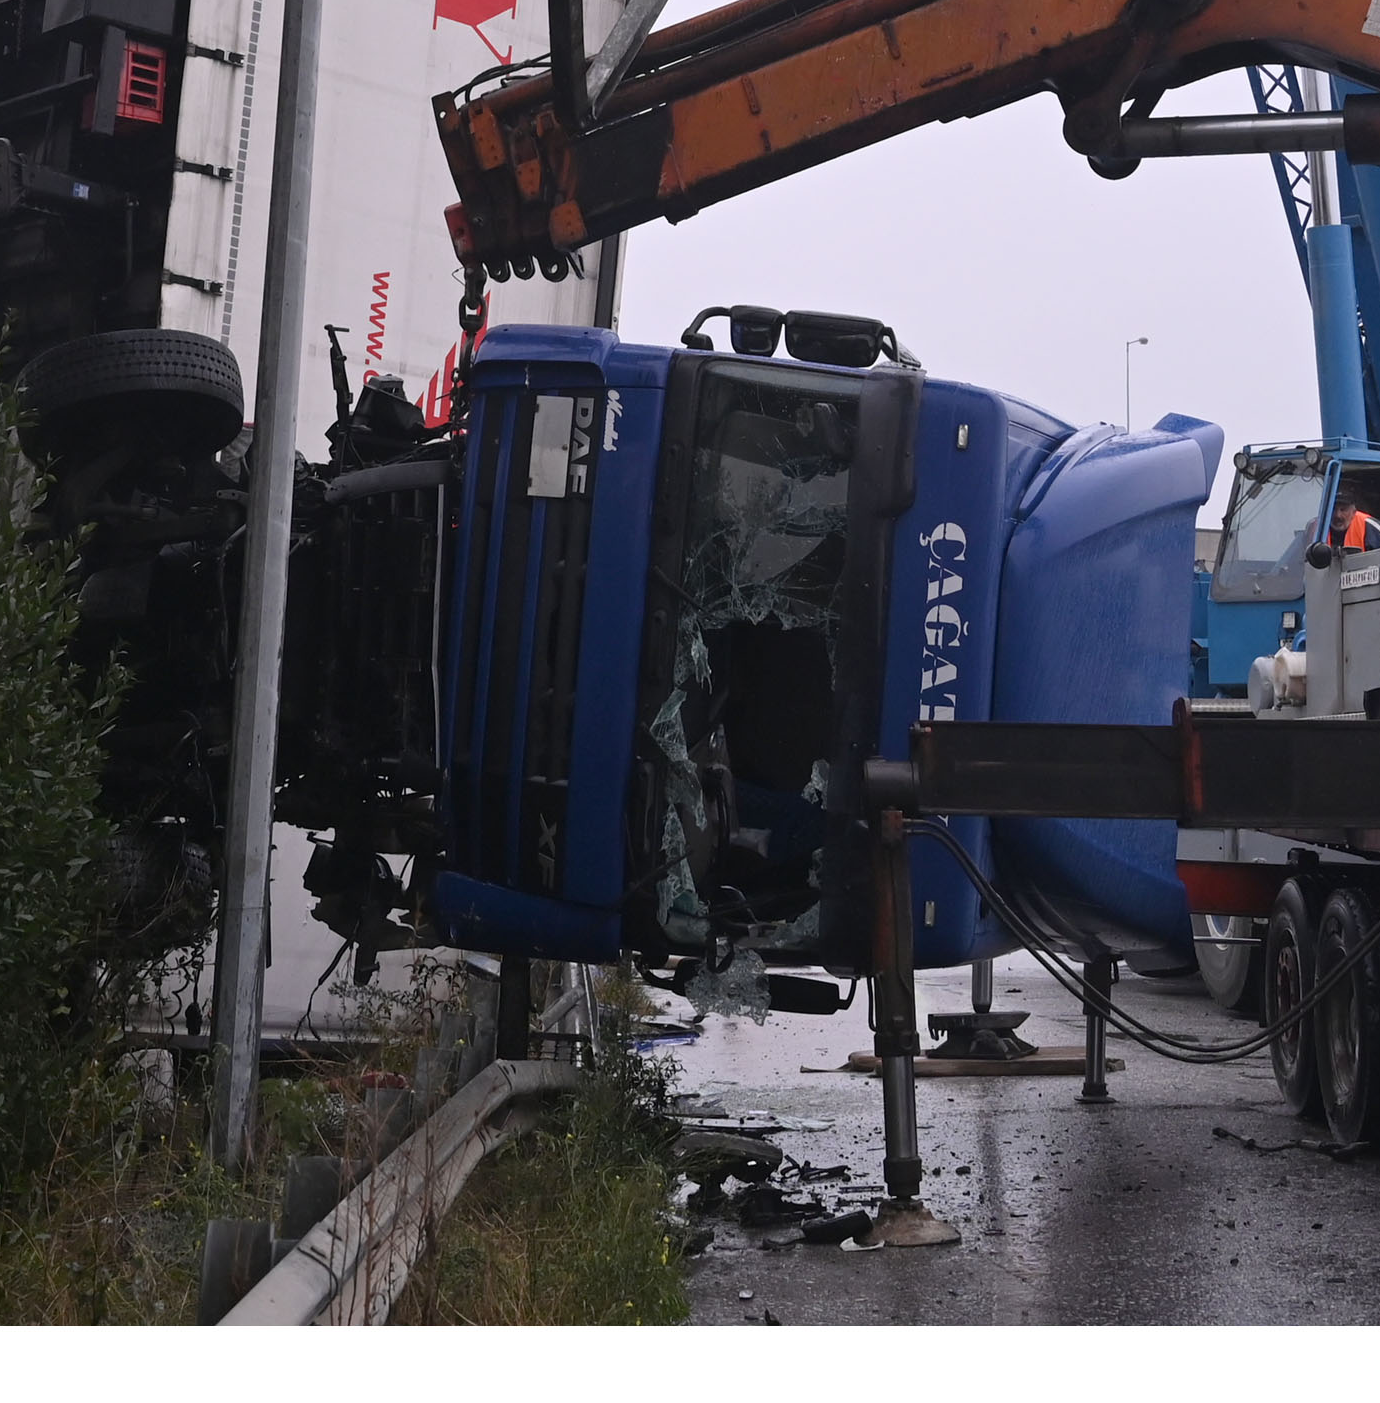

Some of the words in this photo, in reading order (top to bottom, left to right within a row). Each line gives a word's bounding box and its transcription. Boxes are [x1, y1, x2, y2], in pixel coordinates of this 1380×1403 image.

[568, 396, 595, 494] DAF
[918, 521, 970, 828] ÇAĞAT
[538, 812, 558, 890] XF
